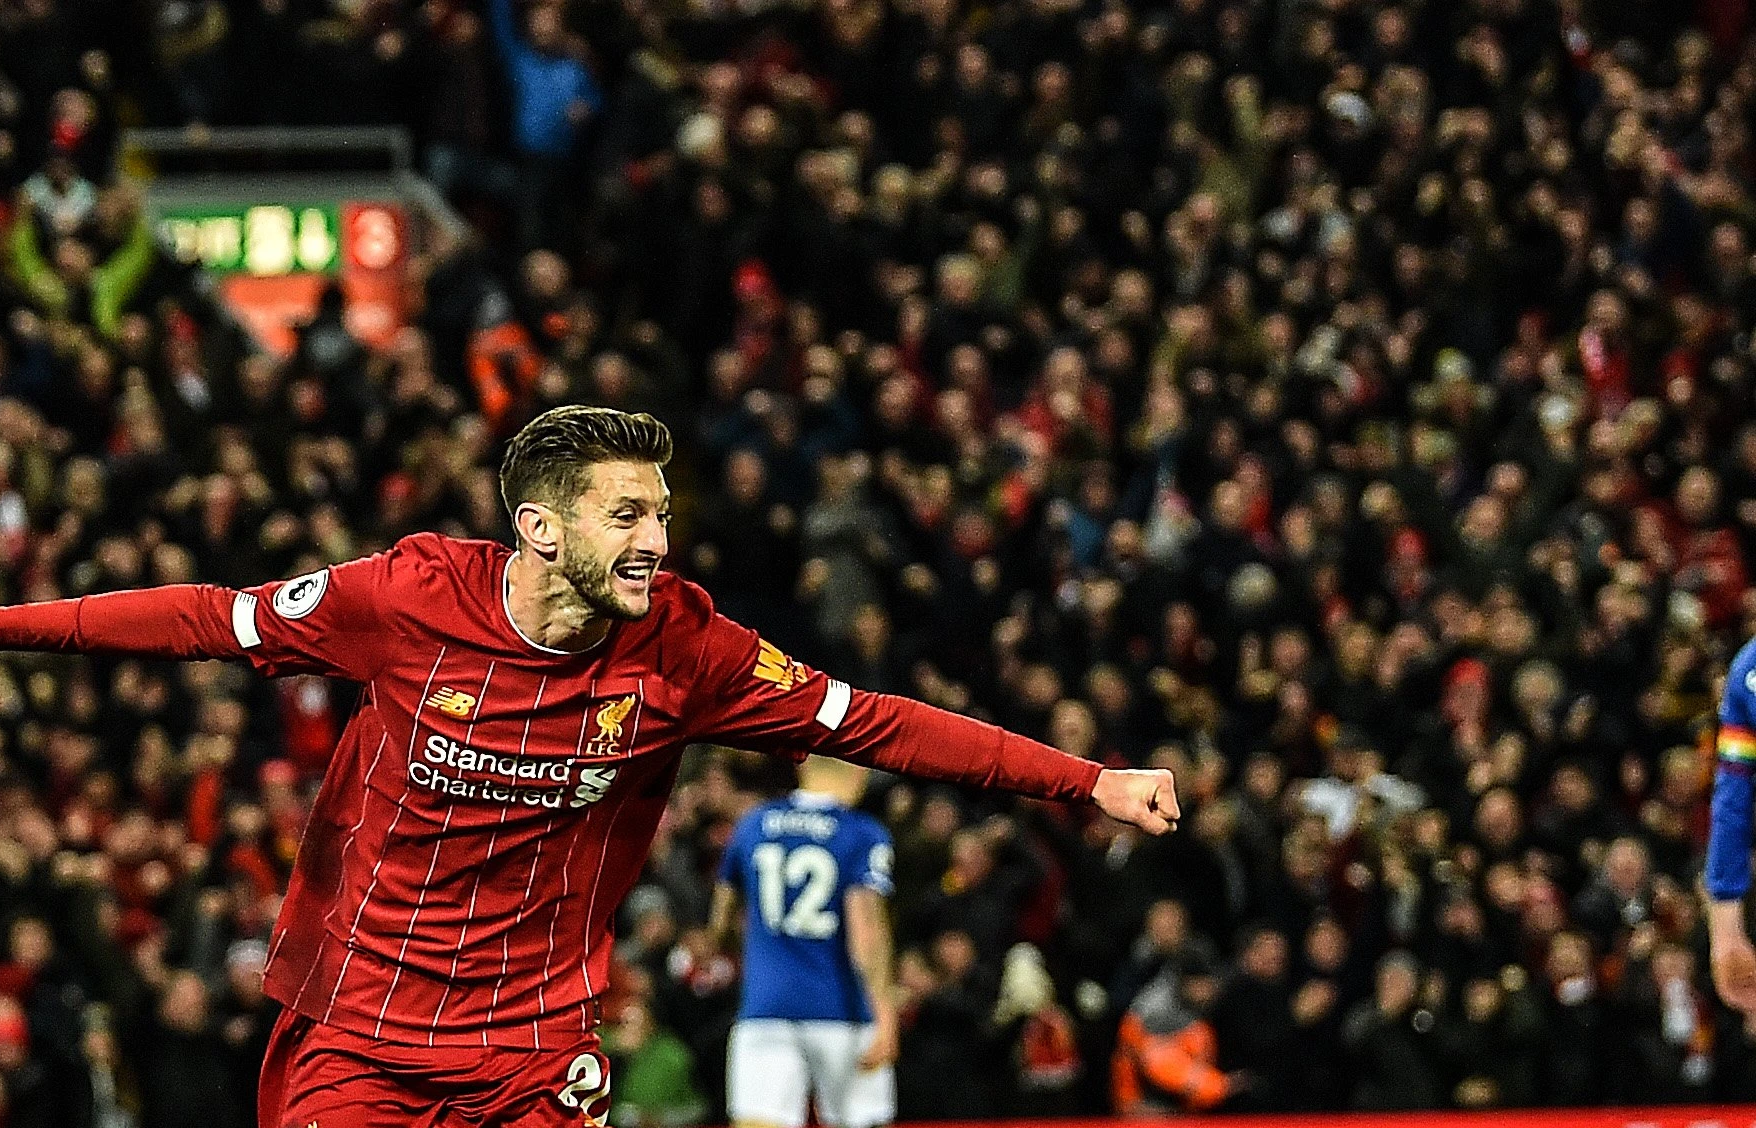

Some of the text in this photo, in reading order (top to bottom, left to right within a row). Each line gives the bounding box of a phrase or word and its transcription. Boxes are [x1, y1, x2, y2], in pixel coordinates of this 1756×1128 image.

[424, 735, 575, 782] Standard
[408, 762, 564, 809] Chartered
[752, 842, 840, 940] 12
